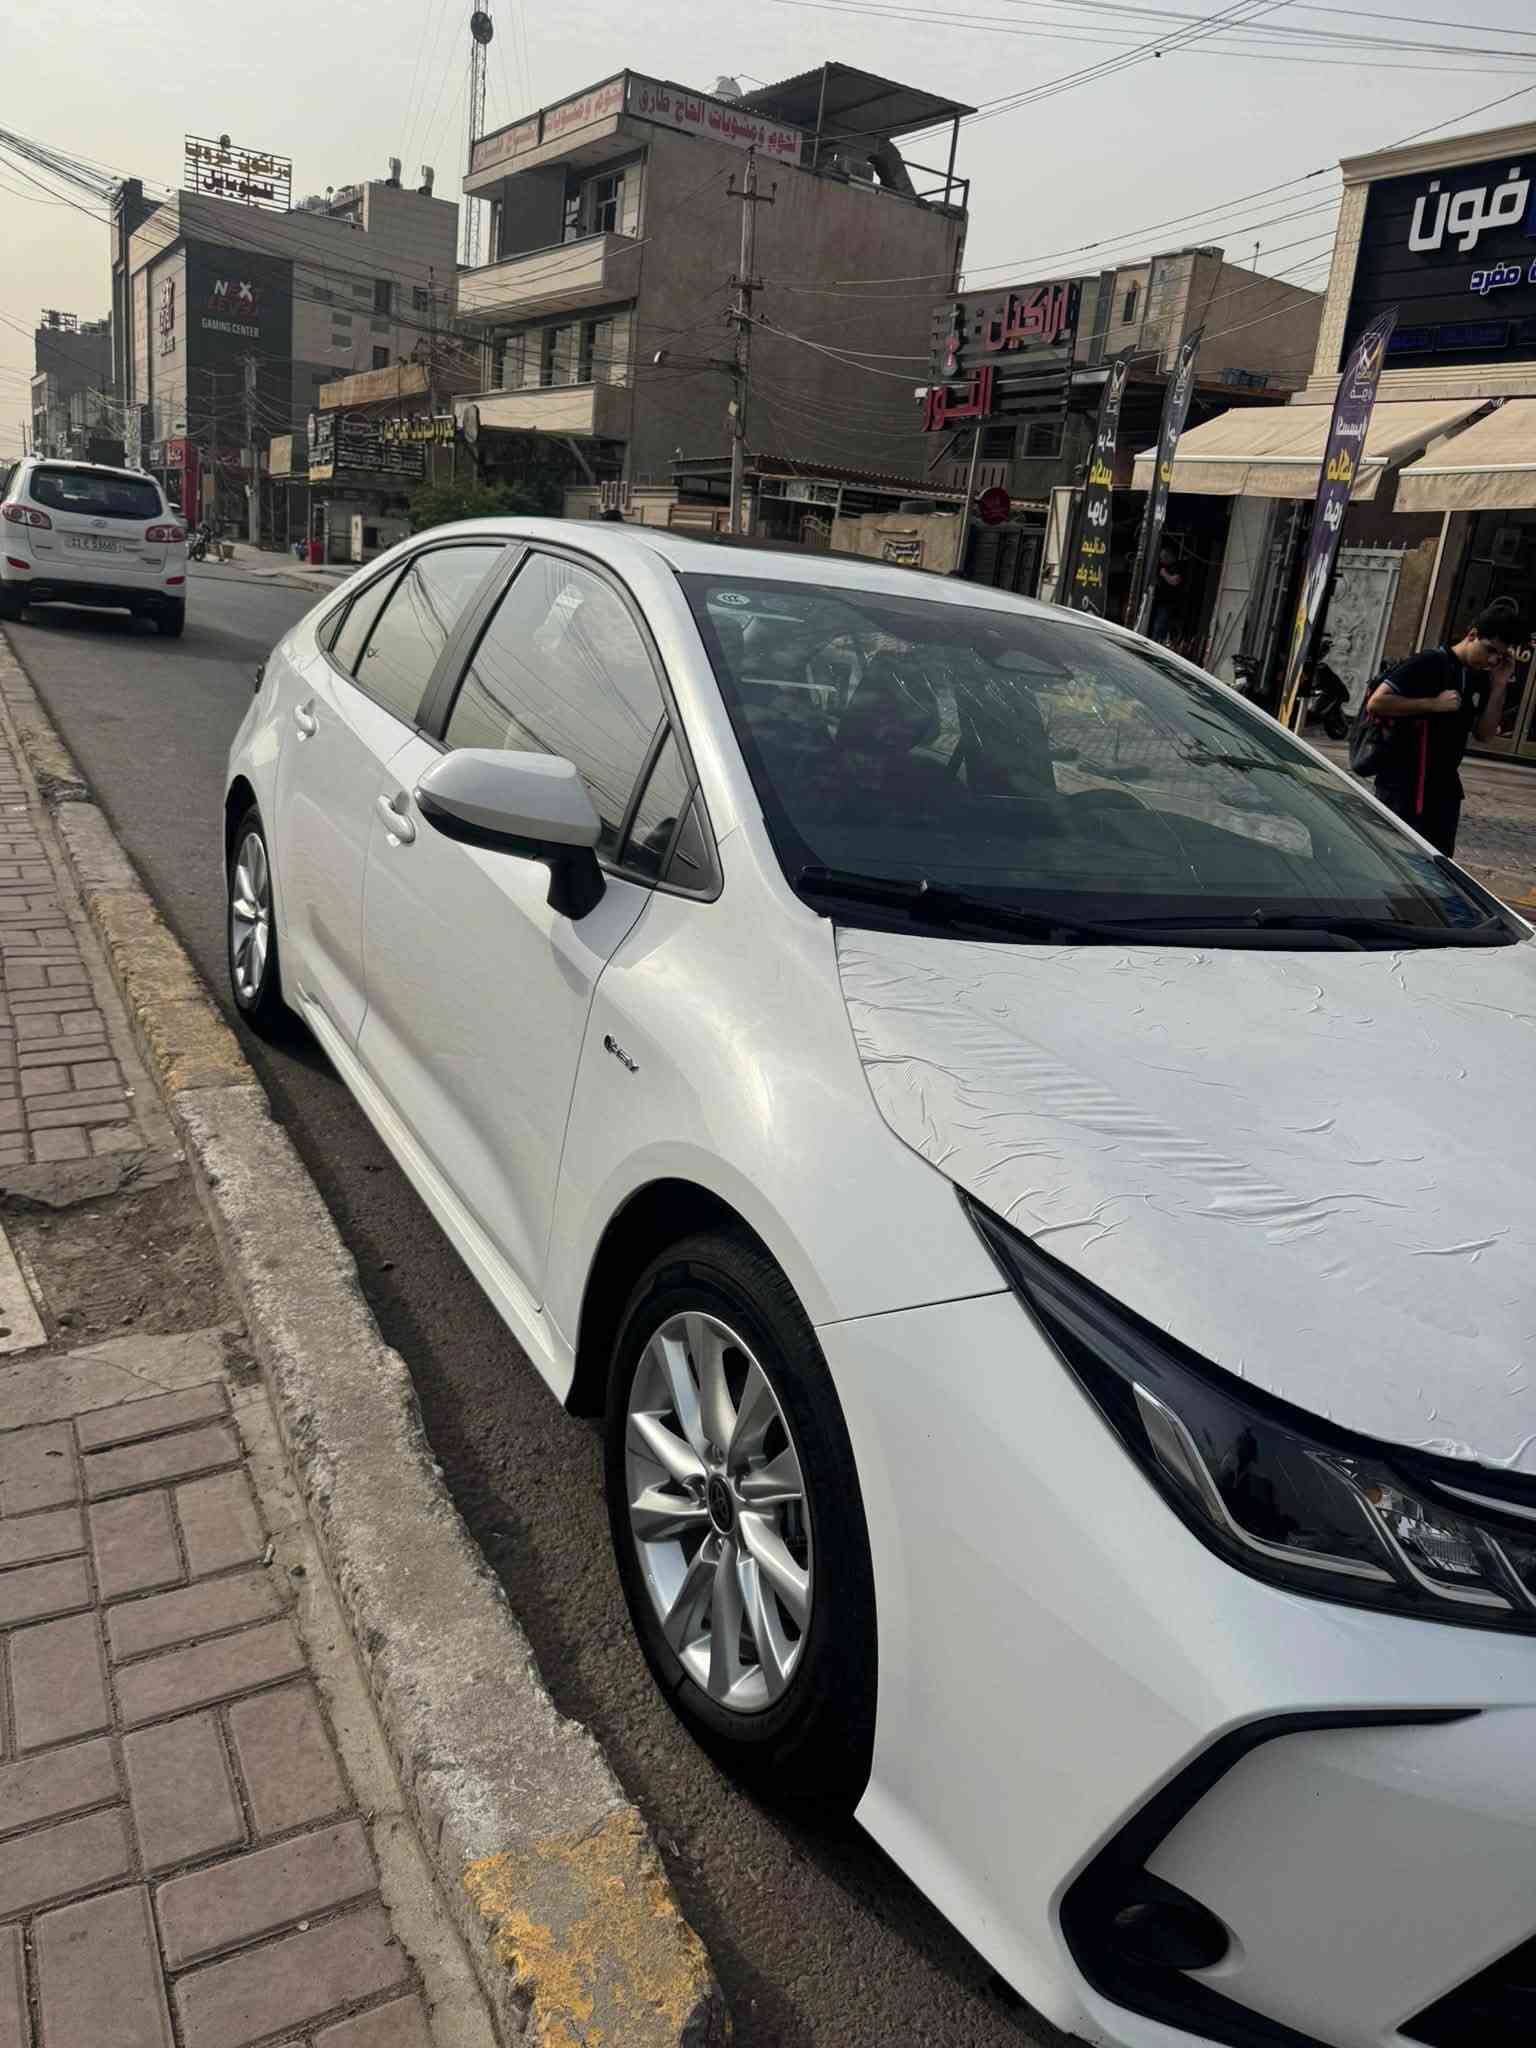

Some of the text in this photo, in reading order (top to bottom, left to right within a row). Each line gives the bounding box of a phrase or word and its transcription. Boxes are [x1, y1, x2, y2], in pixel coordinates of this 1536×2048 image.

[1408, 167, 1531, 252] فون
[1470, 262, 1521, 295] مفرد
[201, 317, 260, 338] GAMING CENTER
